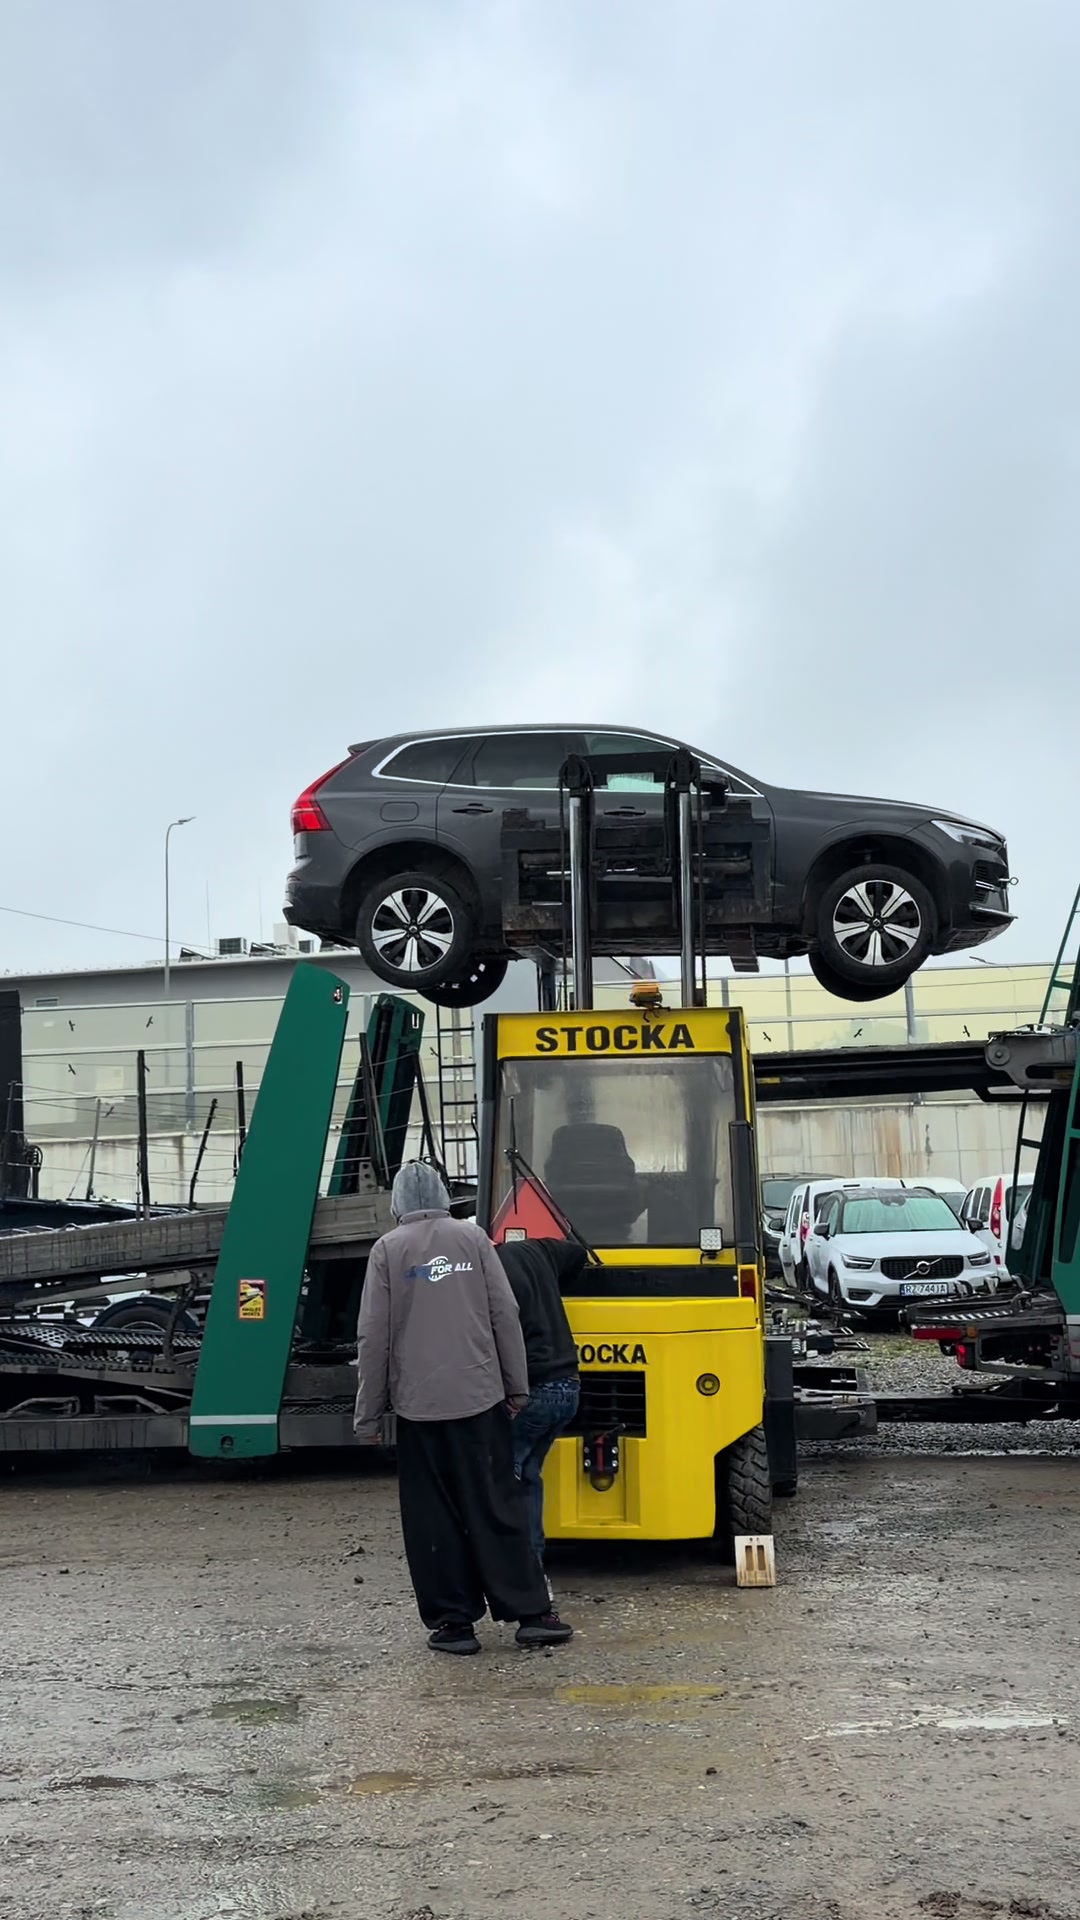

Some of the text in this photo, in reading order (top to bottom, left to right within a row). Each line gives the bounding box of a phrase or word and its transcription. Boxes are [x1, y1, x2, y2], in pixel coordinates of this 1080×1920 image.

[535, 1024, 695, 1052] STOCKA
[430, 1264, 452, 1275] FOR
[454, 1262, 473, 1271] ALL
[575, 1343, 648, 1364] OCKA
